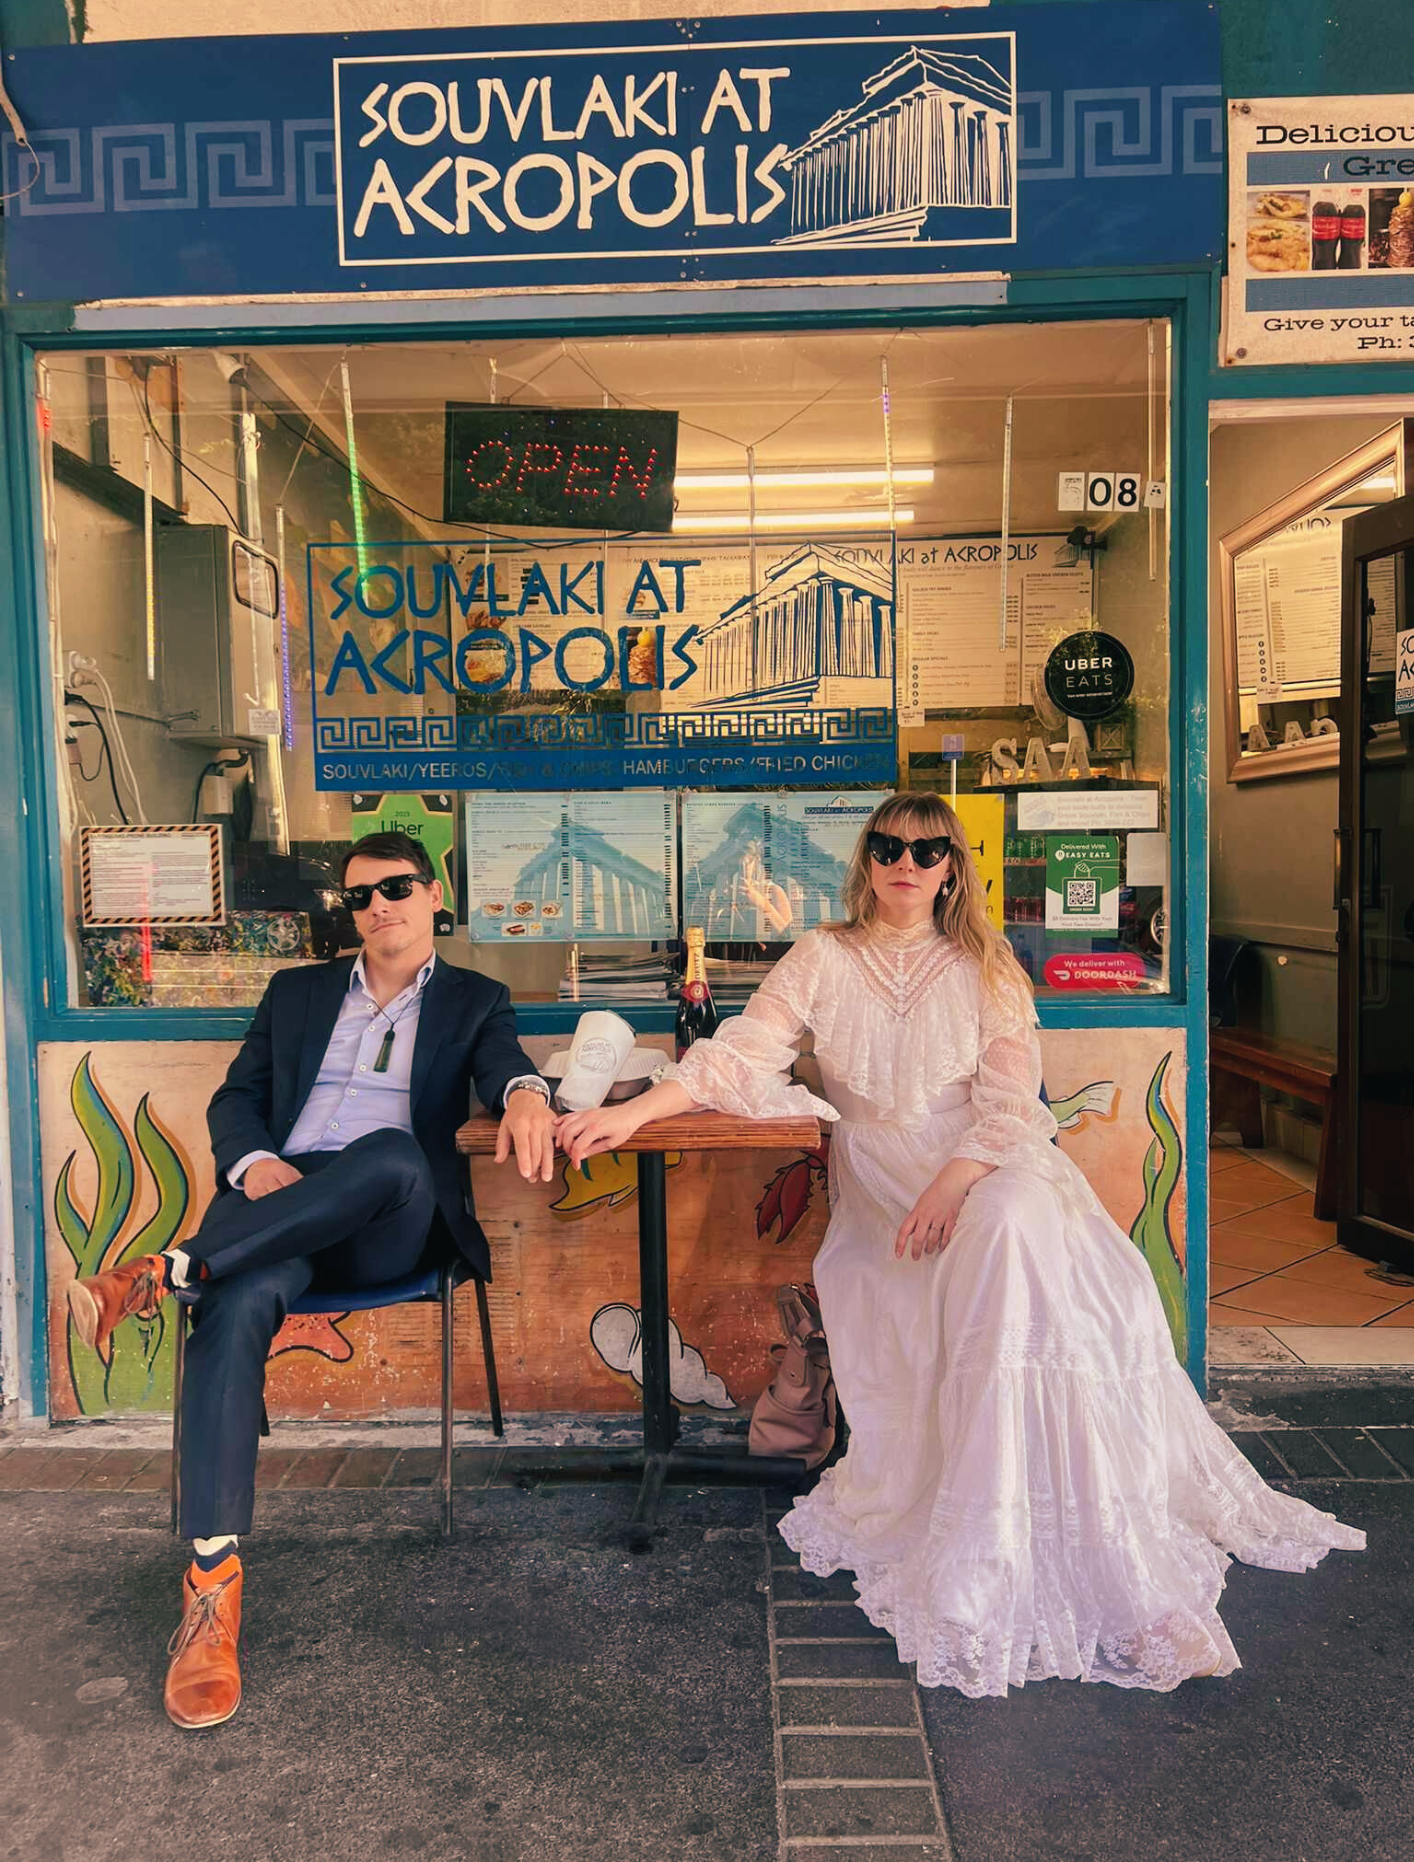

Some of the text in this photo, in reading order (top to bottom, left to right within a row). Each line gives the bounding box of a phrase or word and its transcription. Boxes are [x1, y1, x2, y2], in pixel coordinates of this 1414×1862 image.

[359, 67, 791, 147] SOUVLAKI AT
[354, 143, 788, 238] ACROPOLIS
[1264, 317, 1324, 331] Give
[1330, 316, 1394, 332] your
[1357, 336, 1402, 349] Ph:
[465, 440, 659, 499] OPEN
[921, 546, 939, 565] at
[944, 543, 1039, 564] ACROPOLIS
[330, 560, 605, 619] SOUVLAKI
[626, 558, 701, 615] AT
[324, 624, 700, 696] ACROPOLIS
[1064, 656, 1113, 671] UBER
[1066, 673, 1113, 688] EATS
[381, 820, 424, 835] Uber
[1065, 851, 1086, 859] EASY
[1064, 959, 1126, 968] We deliver with
[1074, 970, 1137, 981] DOORDASH
